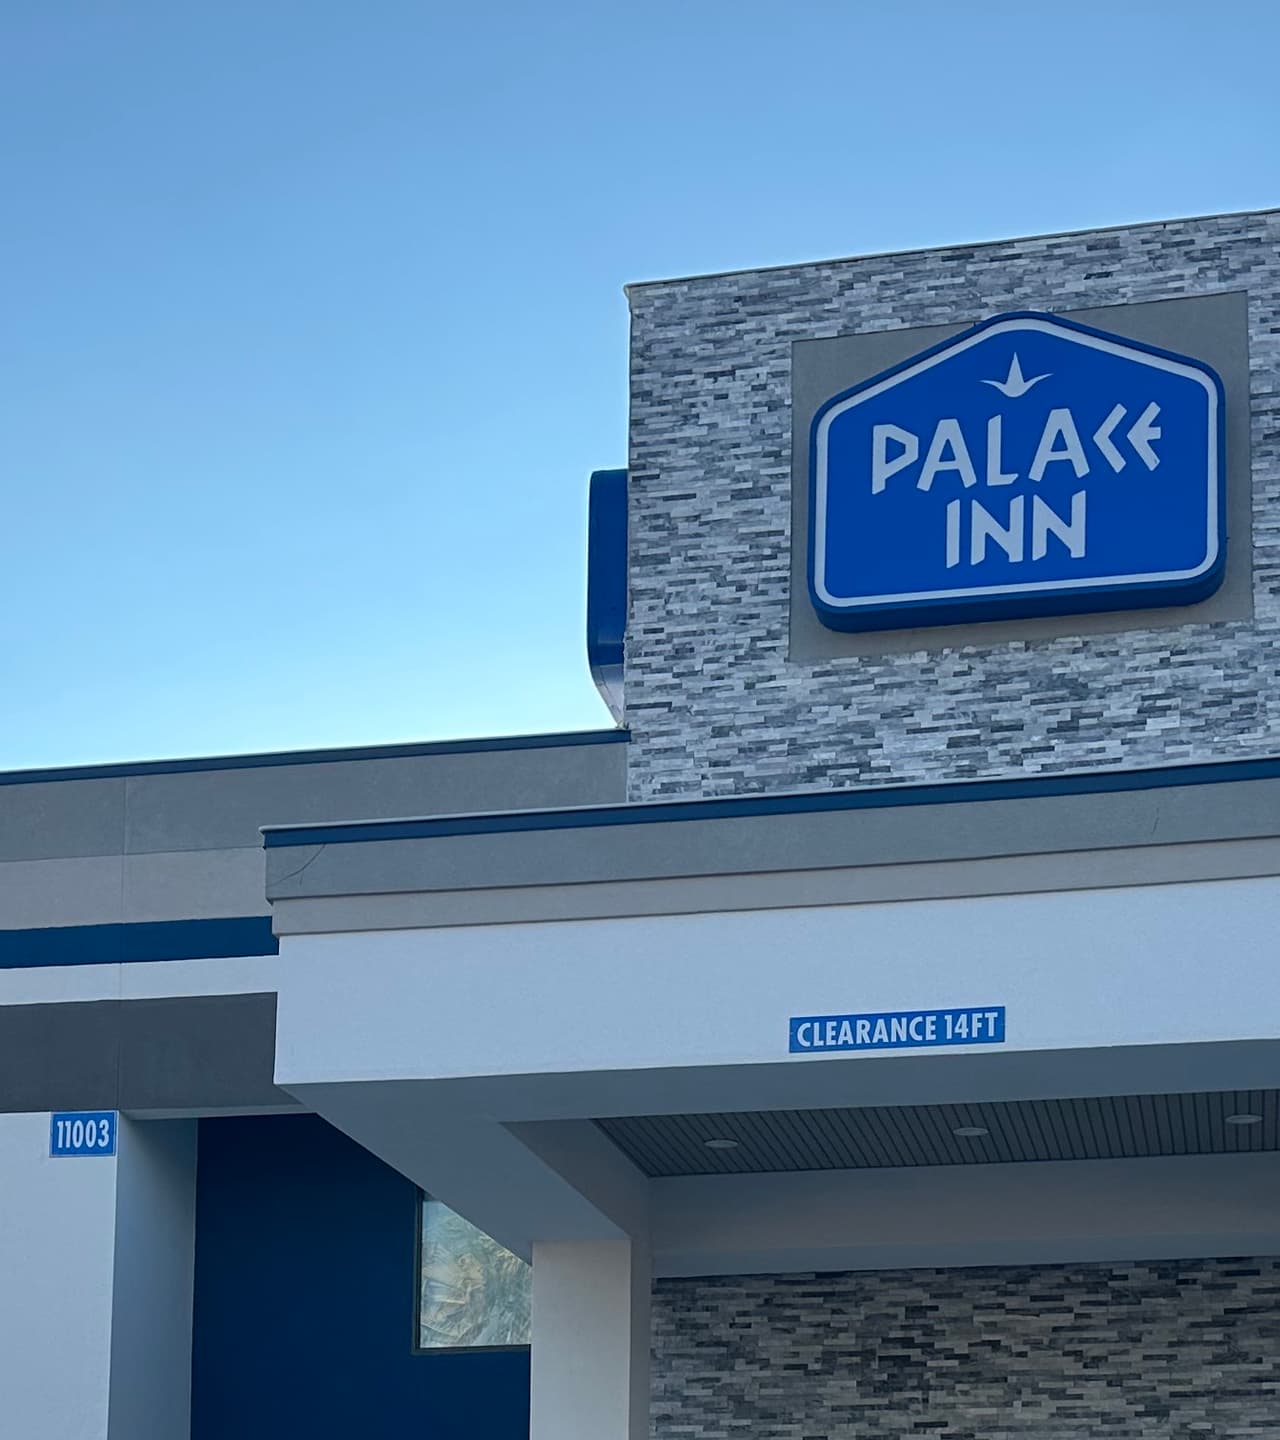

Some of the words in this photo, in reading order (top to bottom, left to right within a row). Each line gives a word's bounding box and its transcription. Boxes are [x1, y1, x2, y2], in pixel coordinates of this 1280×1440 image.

[871, 401, 1161, 495] PALACE
[946, 490, 1086, 569] INN
[797, 1015, 937, 1047] CLEARANCE
[944, 1012, 999, 1039] 14FT
[57, 1119, 109, 1148] 11003
